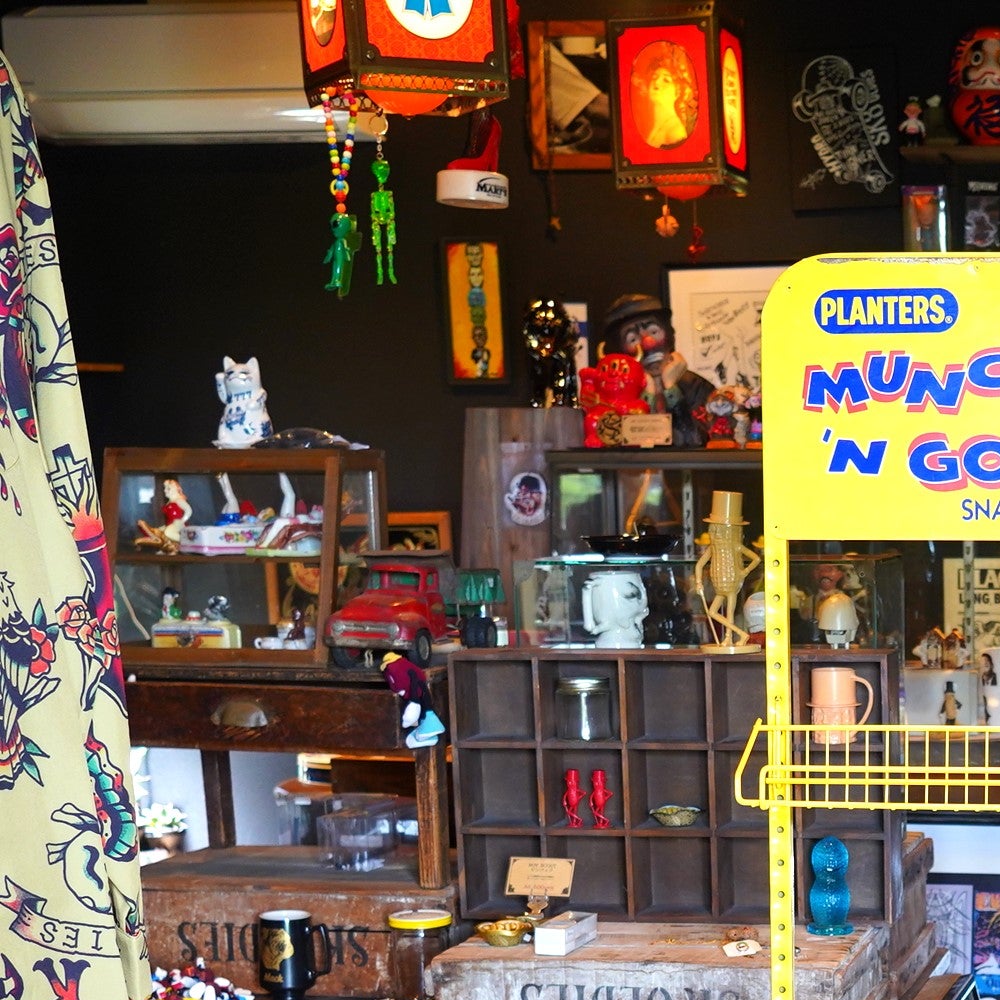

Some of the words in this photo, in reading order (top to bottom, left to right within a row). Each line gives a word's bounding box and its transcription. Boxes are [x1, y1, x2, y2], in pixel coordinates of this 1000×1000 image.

[819, 295, 946, 326] PLANTERS
[821, 428, 887, 474] 'N
[959, 592, 989, 605] LNG
[177, 921, 260, 964] DIES
